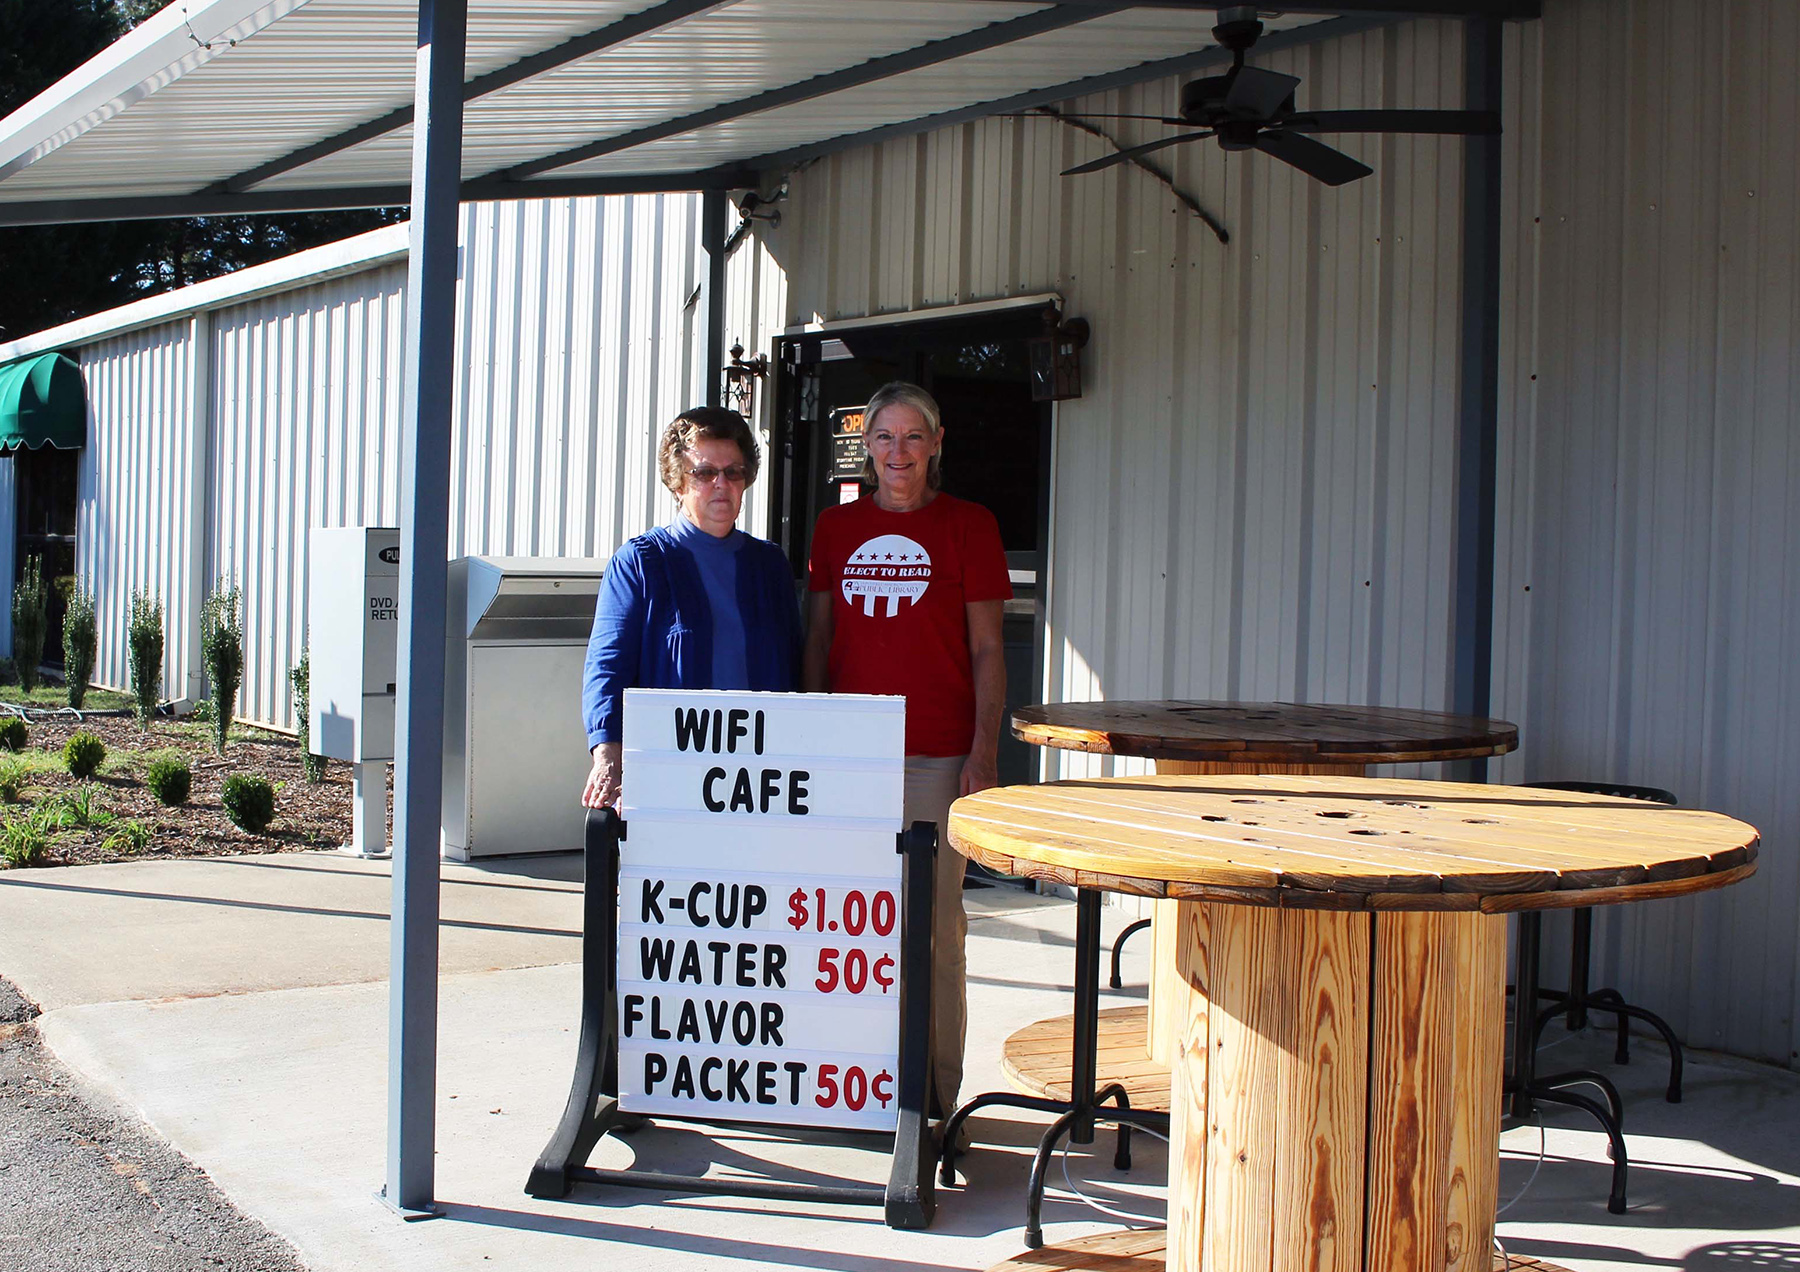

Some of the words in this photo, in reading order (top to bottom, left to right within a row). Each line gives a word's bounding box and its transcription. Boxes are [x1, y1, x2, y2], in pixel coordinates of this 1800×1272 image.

[386, 550, 400, 560] PUL
[843, 567, 878, 575] ELECT
[880, 568, 896, 576] TO
[899, 568, 931, 577] READ
[370, 598, 392, 608] DVD
[372, 610, 399, 620] RETU
[675, 707, 764, 755] WIFI
[702, 766, 810, 815] CAFE
[642, 879, 767, 929] K-CUP
[788, 887, 896, 937] $1.00
[640, 936, 787, 989] WATER
[815, 947, 895, 994] 50¢
[623, 995, 784, 1047] FLAVOR
[644, 1053, 808, 1106] PACKET
[815, 1064, 893, 1111] 50¢
